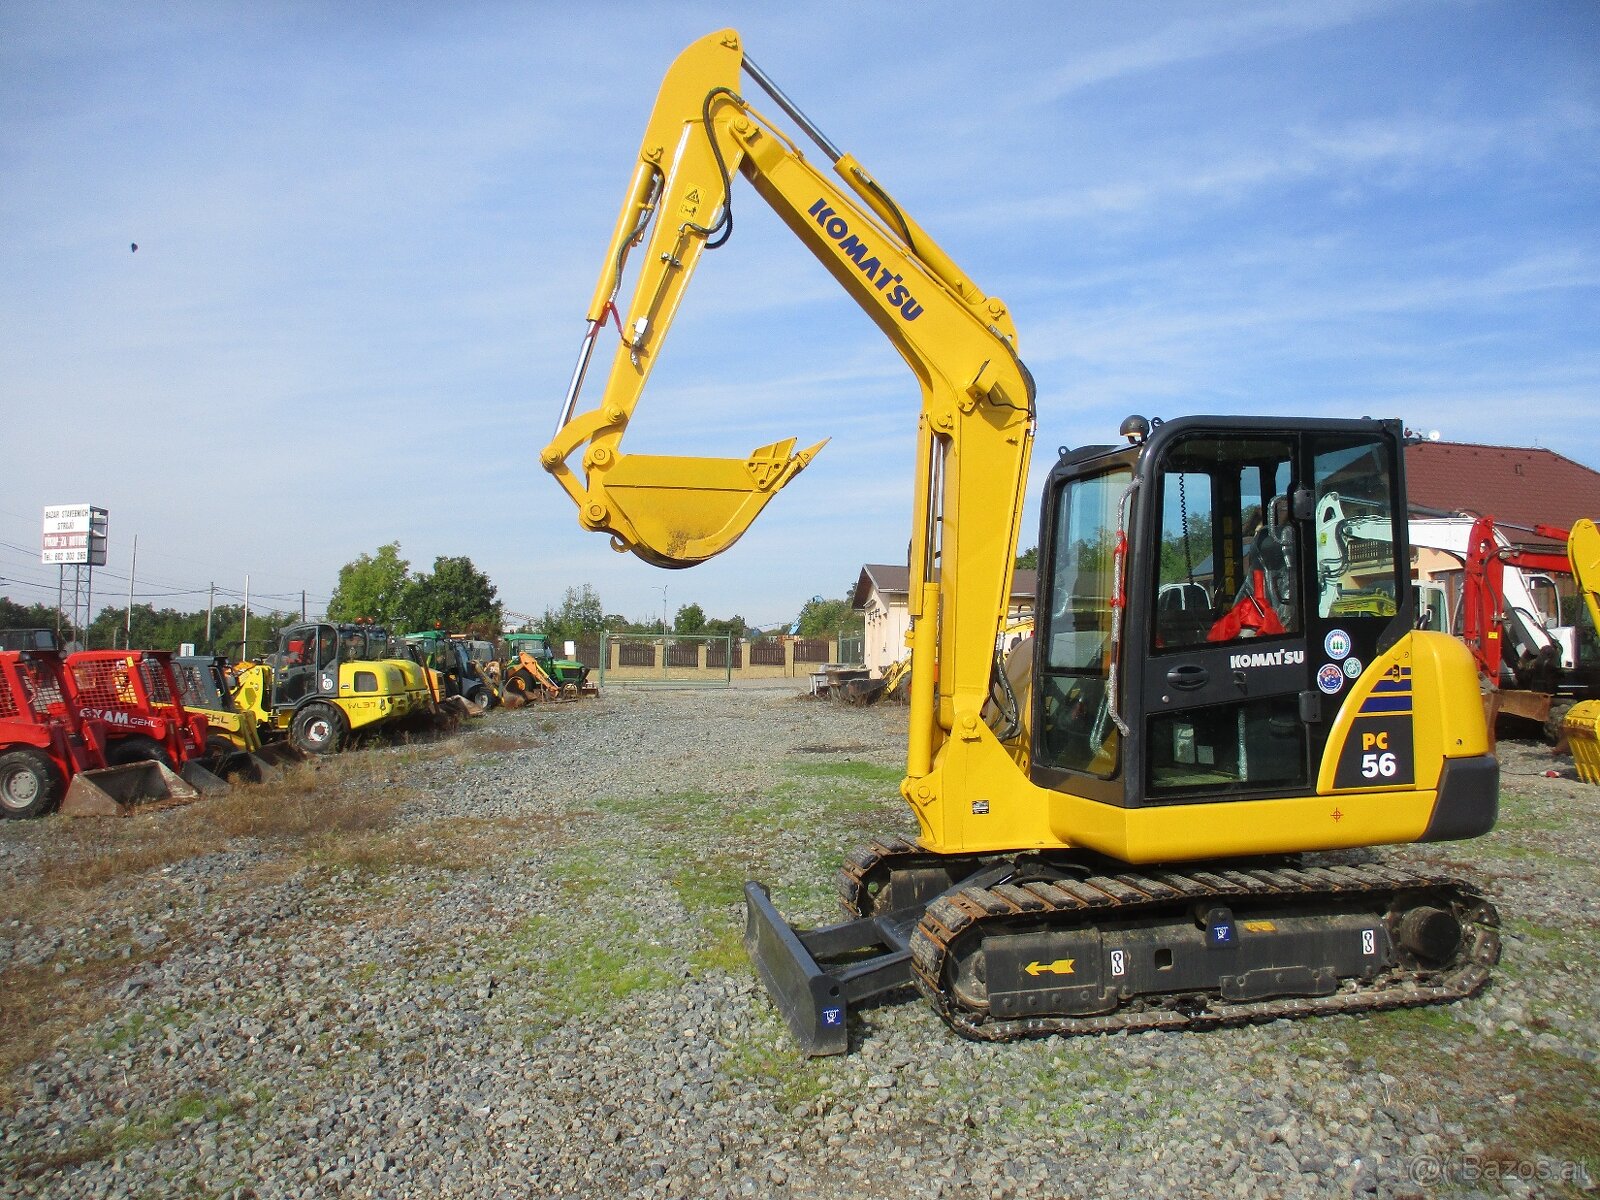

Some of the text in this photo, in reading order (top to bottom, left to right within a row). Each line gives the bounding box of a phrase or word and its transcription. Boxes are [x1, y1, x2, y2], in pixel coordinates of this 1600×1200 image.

[807, 197, 924, 321] KOMATSU
[1230, 649, 1304, 669] KOMATSU
[130, 717, 157, 728] GEHL
[1362, 731, 1388, 751] PC
[1361, 752, 1397, 778] 56
